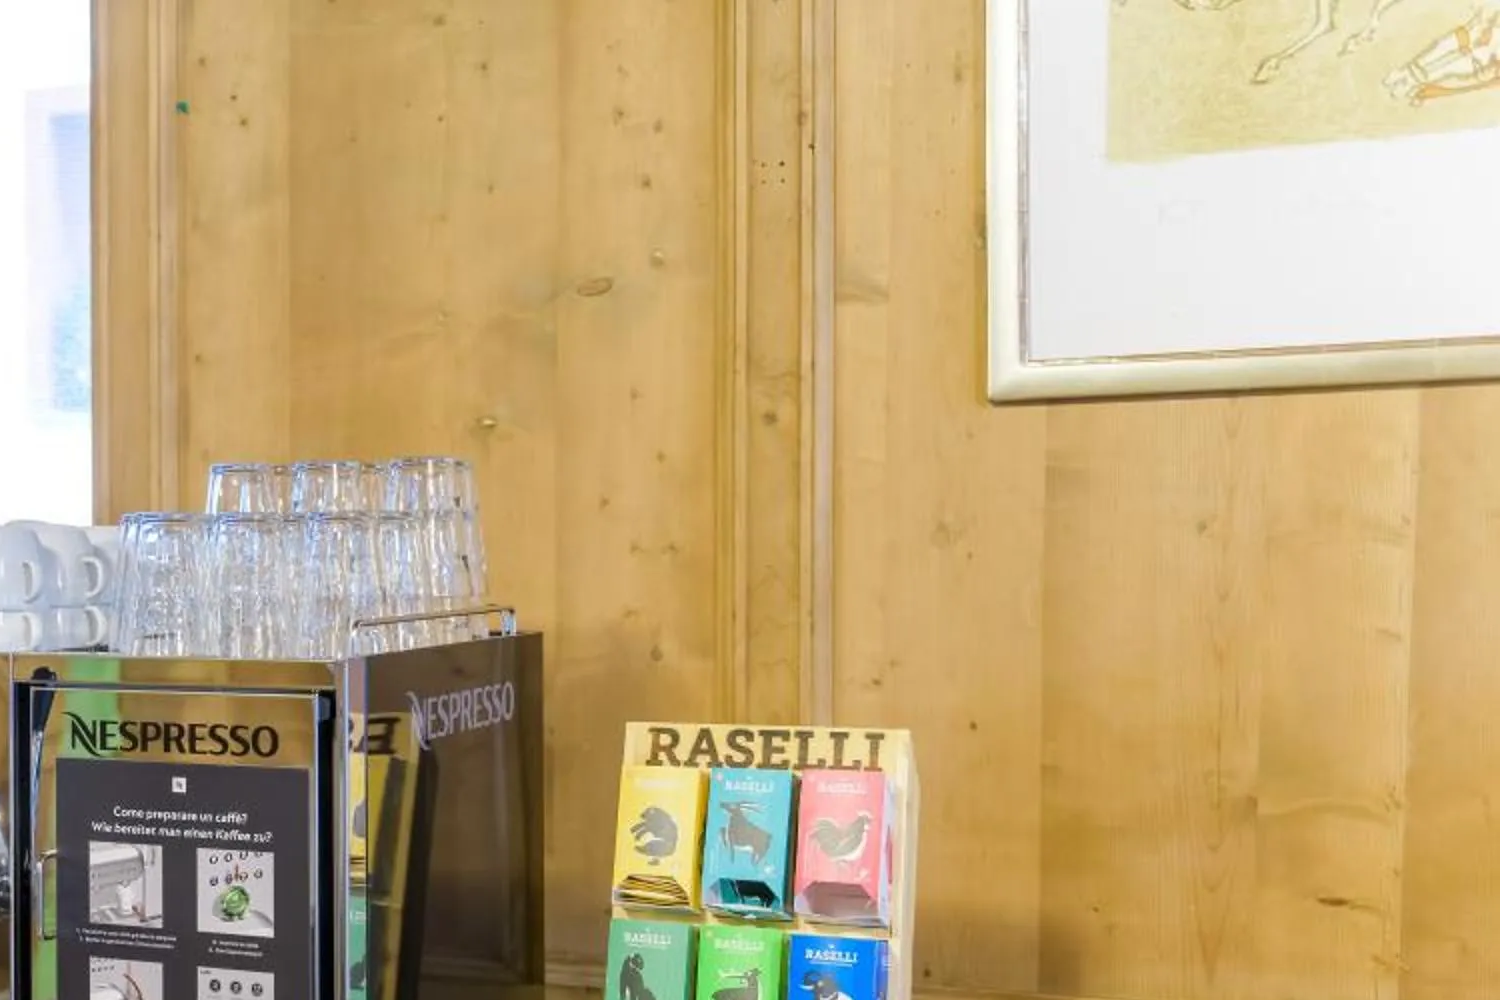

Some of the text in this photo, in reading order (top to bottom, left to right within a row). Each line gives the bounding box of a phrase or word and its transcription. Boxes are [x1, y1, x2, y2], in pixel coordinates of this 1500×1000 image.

[405, 681, 515, 750] NESPRESSO
[62, 711, 280, 758] NESPRESSO
[645, 727, 885, 771] RASELLI
[724, 780, 775, 794] RASELLI
[113, 806, 145, 818] Come
[145, 810, 198, 822] preparare
[199, 813, 213, 822] un
[91, 821, 113, 833] Wie
[158, 827, 182, 837] man
[183, 827, 214, 840] einen
[252, 832, 274, 844] zu?
[804, 948, 859, 963] RASELLI
